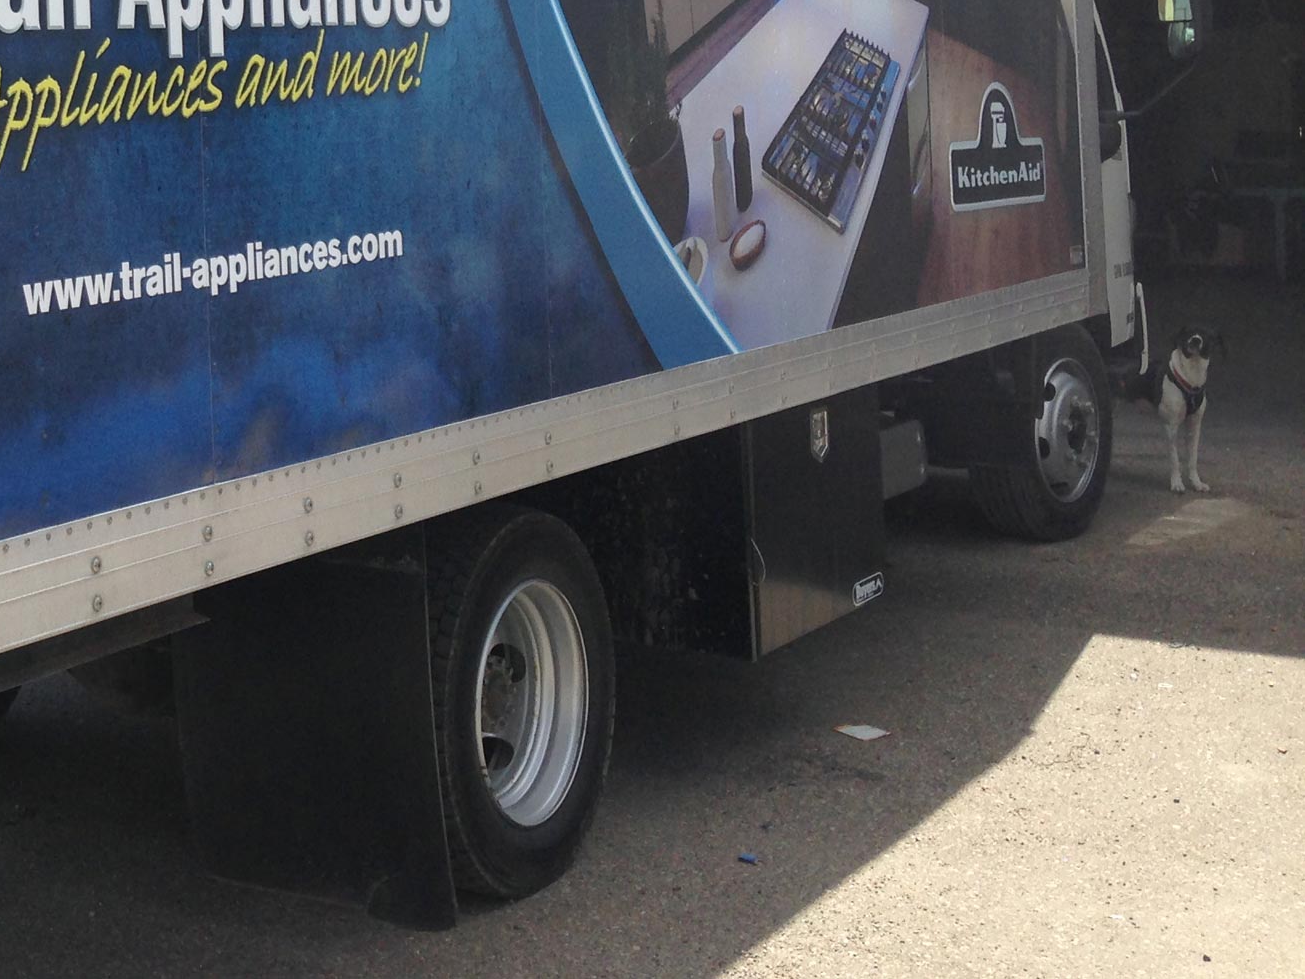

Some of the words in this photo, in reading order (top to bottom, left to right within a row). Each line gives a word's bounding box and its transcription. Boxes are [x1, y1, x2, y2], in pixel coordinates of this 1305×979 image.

[235, 28, 325, 109] and
[326, 31, 429, 96] more!
[957, 161, 1041, 189] KitchenAid
[22, 228, 404, 316] www.trail-appliances.com
